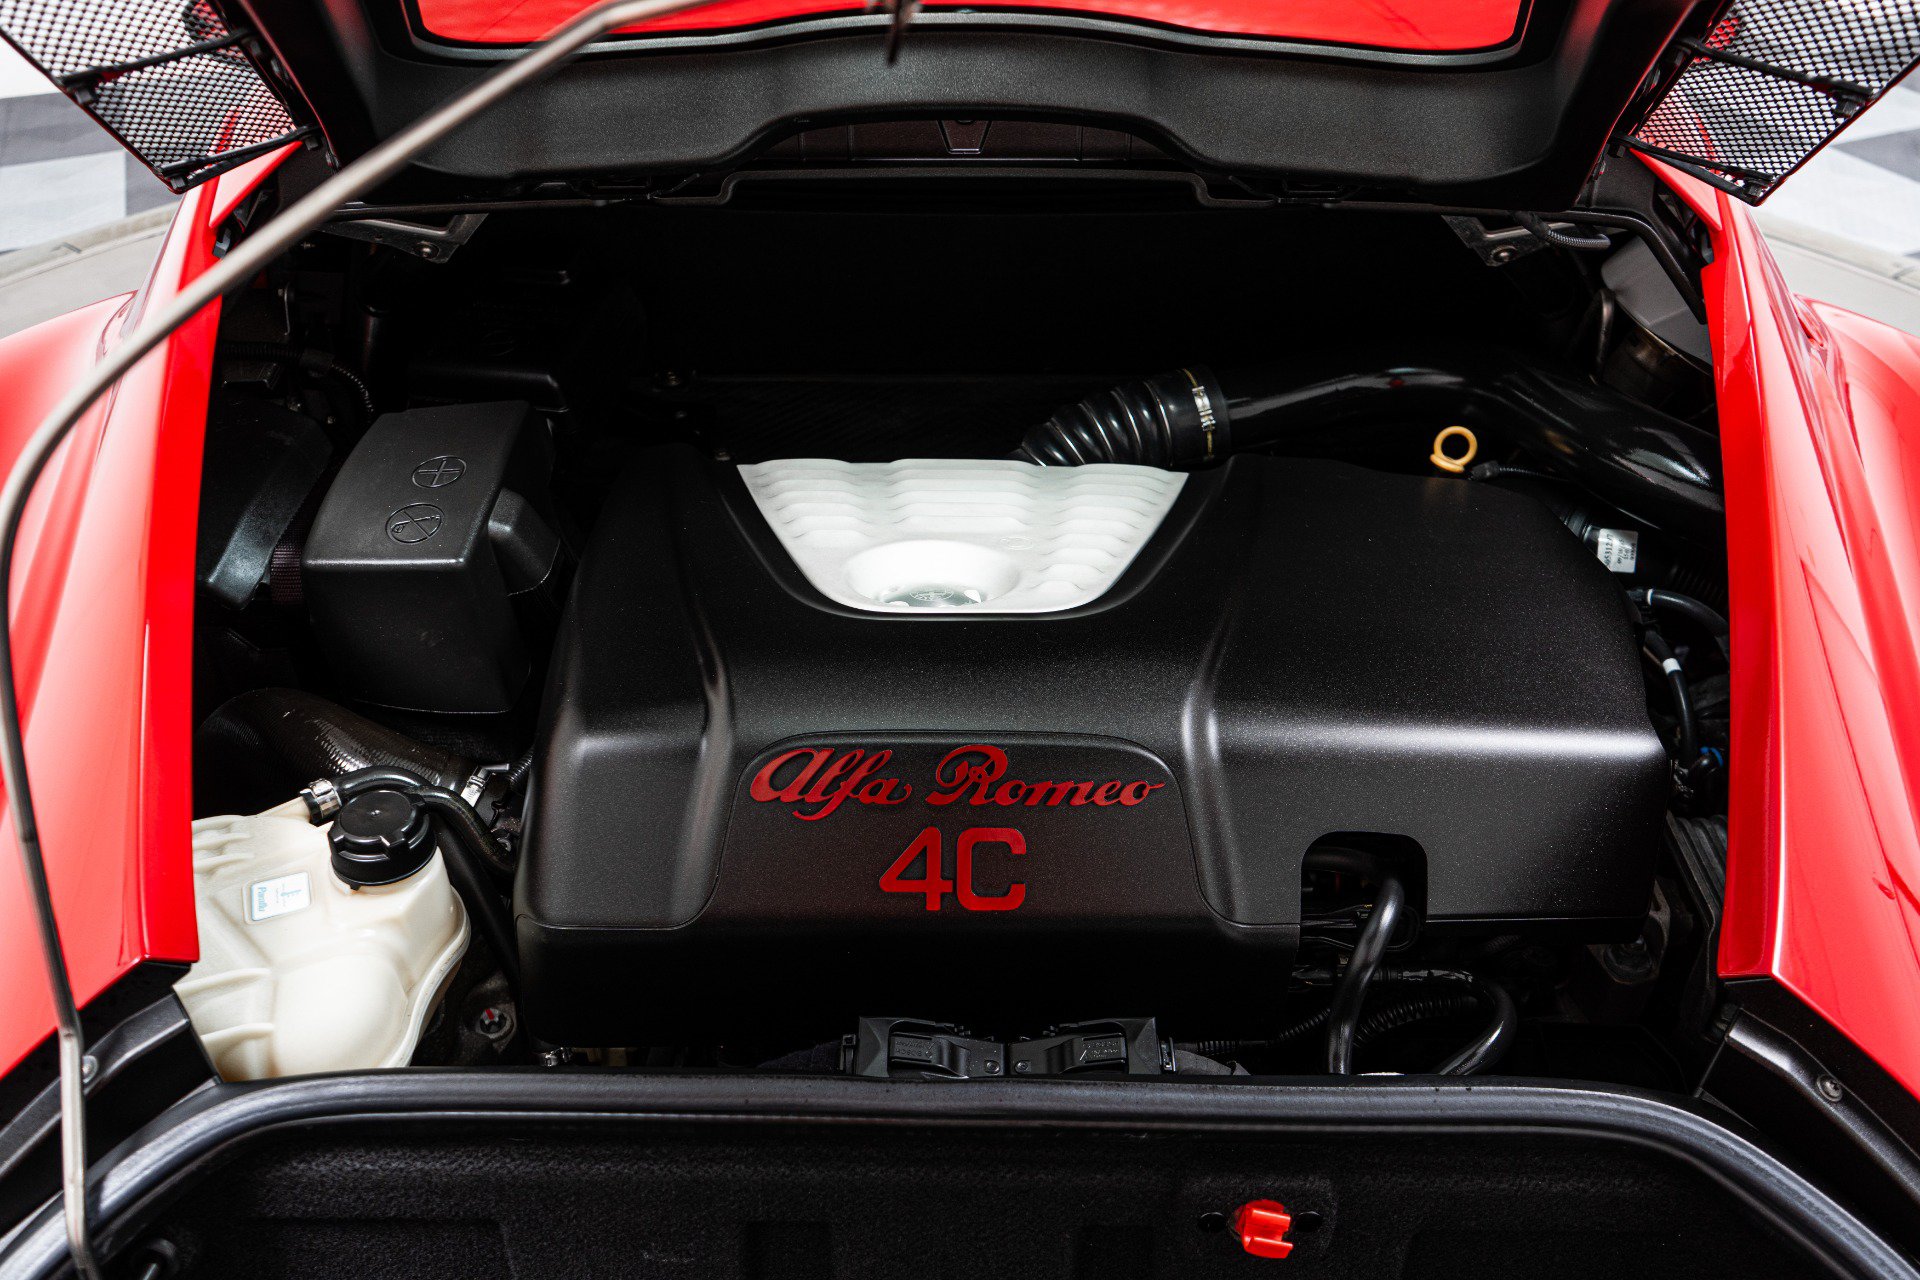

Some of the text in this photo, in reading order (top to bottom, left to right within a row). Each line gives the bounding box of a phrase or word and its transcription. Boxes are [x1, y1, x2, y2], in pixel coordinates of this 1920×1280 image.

[749, 744, 1166, 821] Alfa Romeo
[879, 826, 1027, 911] 4C
